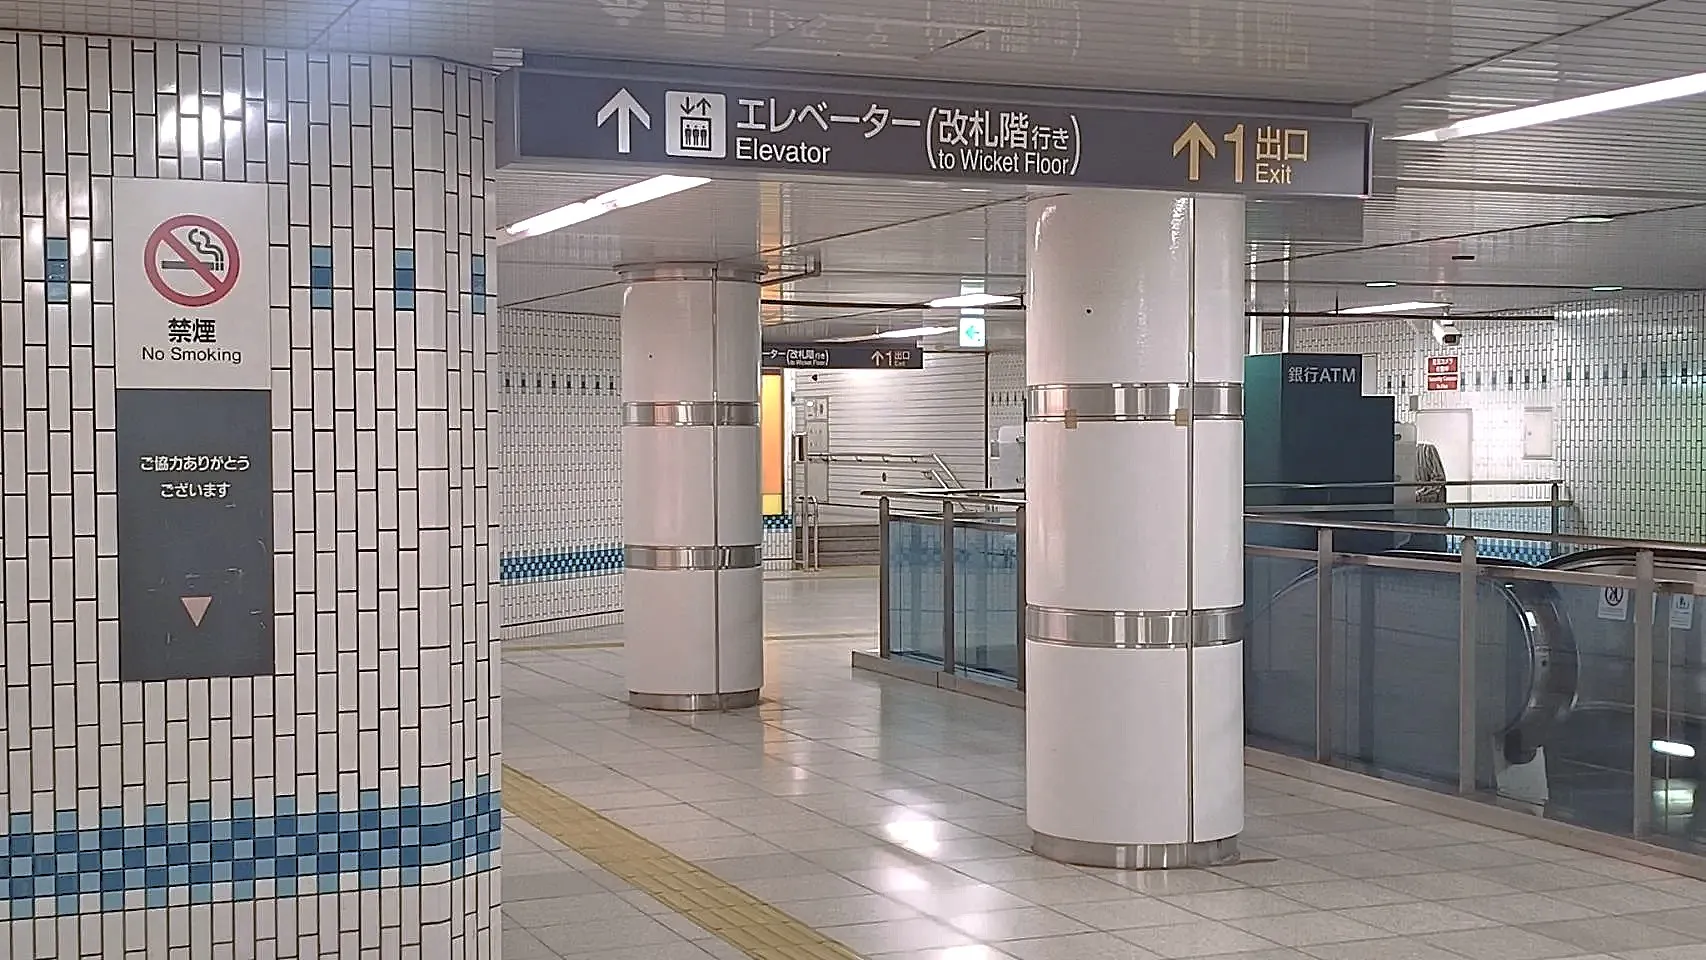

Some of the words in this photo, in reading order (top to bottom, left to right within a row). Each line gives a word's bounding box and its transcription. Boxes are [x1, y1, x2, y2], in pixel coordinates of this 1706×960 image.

[735, 136, 831, 164] Elevator
[1223, 123, 1244, 184] 1
[1255, 126, 1308, 162] 出口
[938, 149, 956, 169] to
[960, 148, 1020, 173] Wicket
[1024, 152, 1070, 175] Floor
[1255, 162, 1292, 184] Exit
[168, 318, 217, 343] 禁煙
[142, 346, 165, 361] No
[170, 346, 242, 364] Smoking
[1288, 366, 1356, 383] 銀行ATM
[140, 455, 250, 471] ご協力ありがとう
[160, 482, 231, 498] ございます
